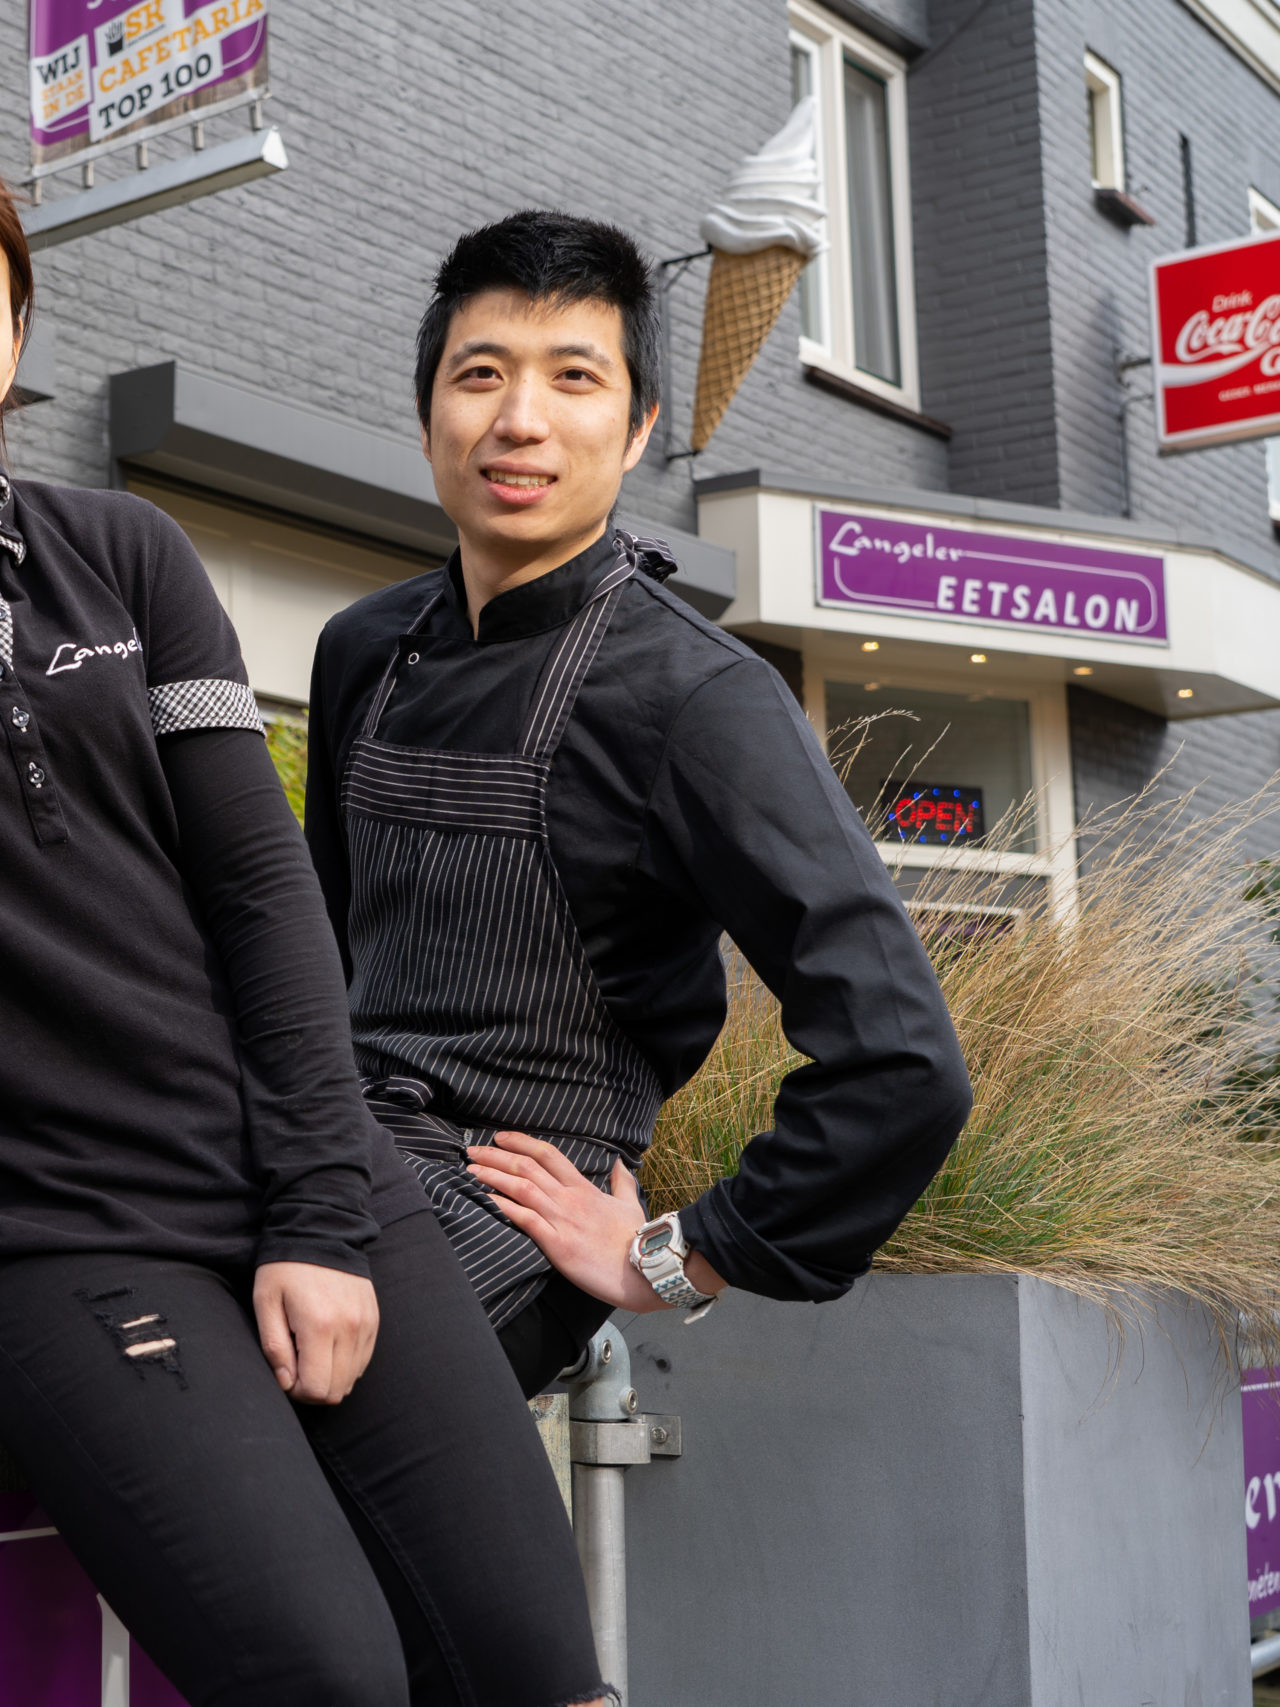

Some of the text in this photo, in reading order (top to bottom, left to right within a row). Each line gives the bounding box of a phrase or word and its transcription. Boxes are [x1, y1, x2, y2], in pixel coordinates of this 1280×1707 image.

[36, 45, 81, 85] WIJ
[98, 0, 264, 93] CAFETARIA
[99, 53, 213, 130] TOP 100
[1212, 290, 1253, 313] Drink
[1175, 294, 1280, 363] Coca-Co
[829, 520, 963, 563] Langeler
[937, 576, 1139, 634] EETSALON
[895, 798, 974, 833] OPEN
